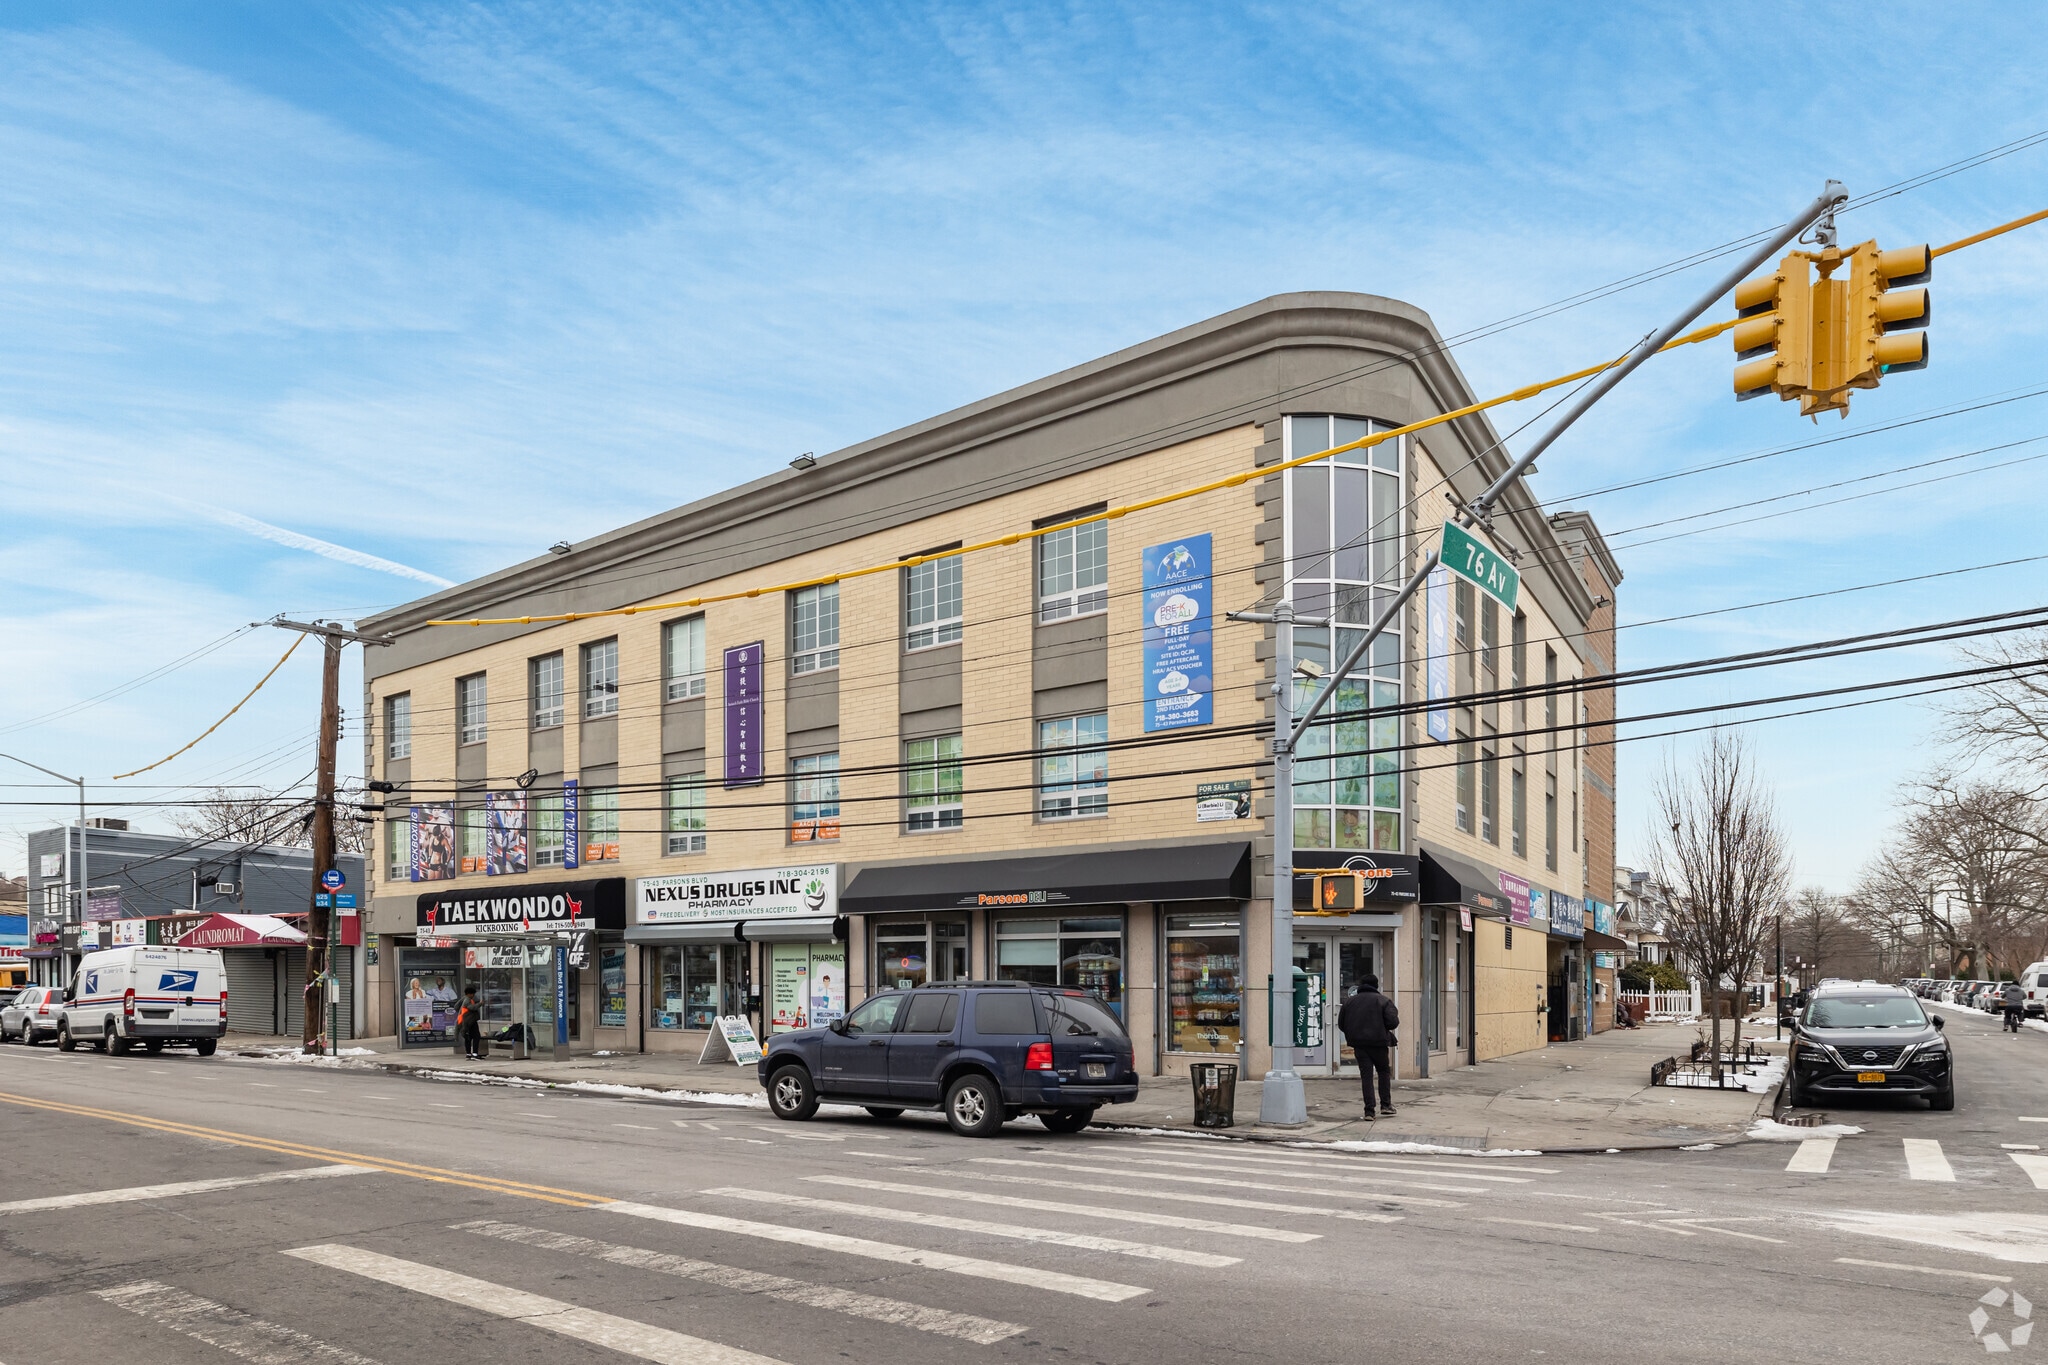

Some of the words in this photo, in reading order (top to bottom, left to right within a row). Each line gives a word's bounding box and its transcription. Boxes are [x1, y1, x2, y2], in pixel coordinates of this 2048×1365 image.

[1466, 542, 1484, 578] 76
[1166, 570, 1188, 580] AACE
[1150, 590, 1166, 599] NOW
[1167, 583, 1202, 596] ENROLLING
[1160, 602, 1185, 614] PRE-K
[1160, 611, 1178, 622] FOR
[1178, 608, 1193, 618] ALL
[1164, 625, 1190, 637] FREE
[1164, 636, 1190, 644] FULL-DAY
[1170, 655, 1200, 665] AFTERCARE
[1177, 662, 1202, 671] VOUCHER
[1156, 696, 1194, 706] ENTRANCE
[1169, 703, 1188, 711] FLOOR
[566, 818, 576, 863] MARTIAL
[777, 868, 829, 878] 718-304-2196
[646, 886, 700, 902] NEXUS
[704, 881, 765, 898] DRUGS
[770, 879, 800, 894] INC
[688, 898, 754, 909] PHARMACY
[978, 893, 1028, 905] Parsons
[1028, 891, 1046, 903] DELI
[441, 894, 566, 922] TAEKWONDO
[476, 923, 519, 933] KICKBOXING
[192, 928, 245, 945] LAUNDROMAT
[492, 957, 504, 965] ONE
[504, 957, 522, 965] WEEK
